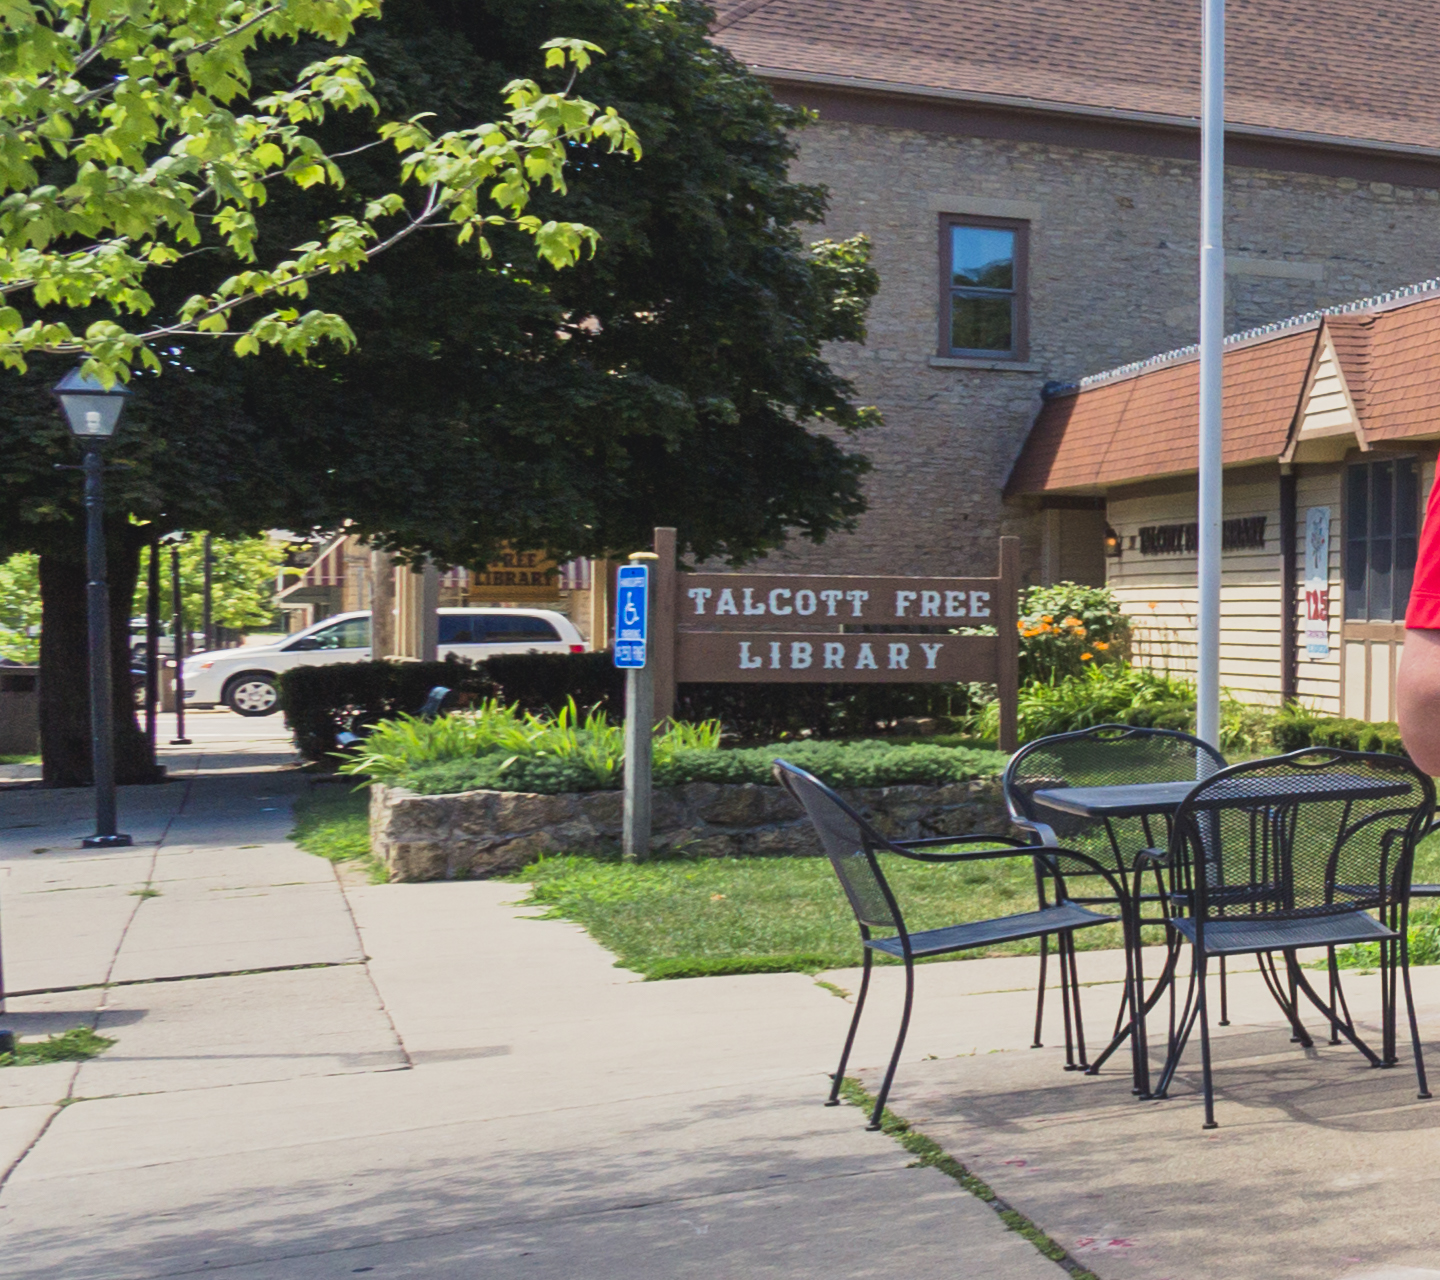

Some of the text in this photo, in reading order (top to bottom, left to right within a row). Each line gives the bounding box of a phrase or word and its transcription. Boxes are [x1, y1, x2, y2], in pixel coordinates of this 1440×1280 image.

[687, 587, 992, 618] TALCOTT FREE
[738, 641, 945, 671] LIBRARY
